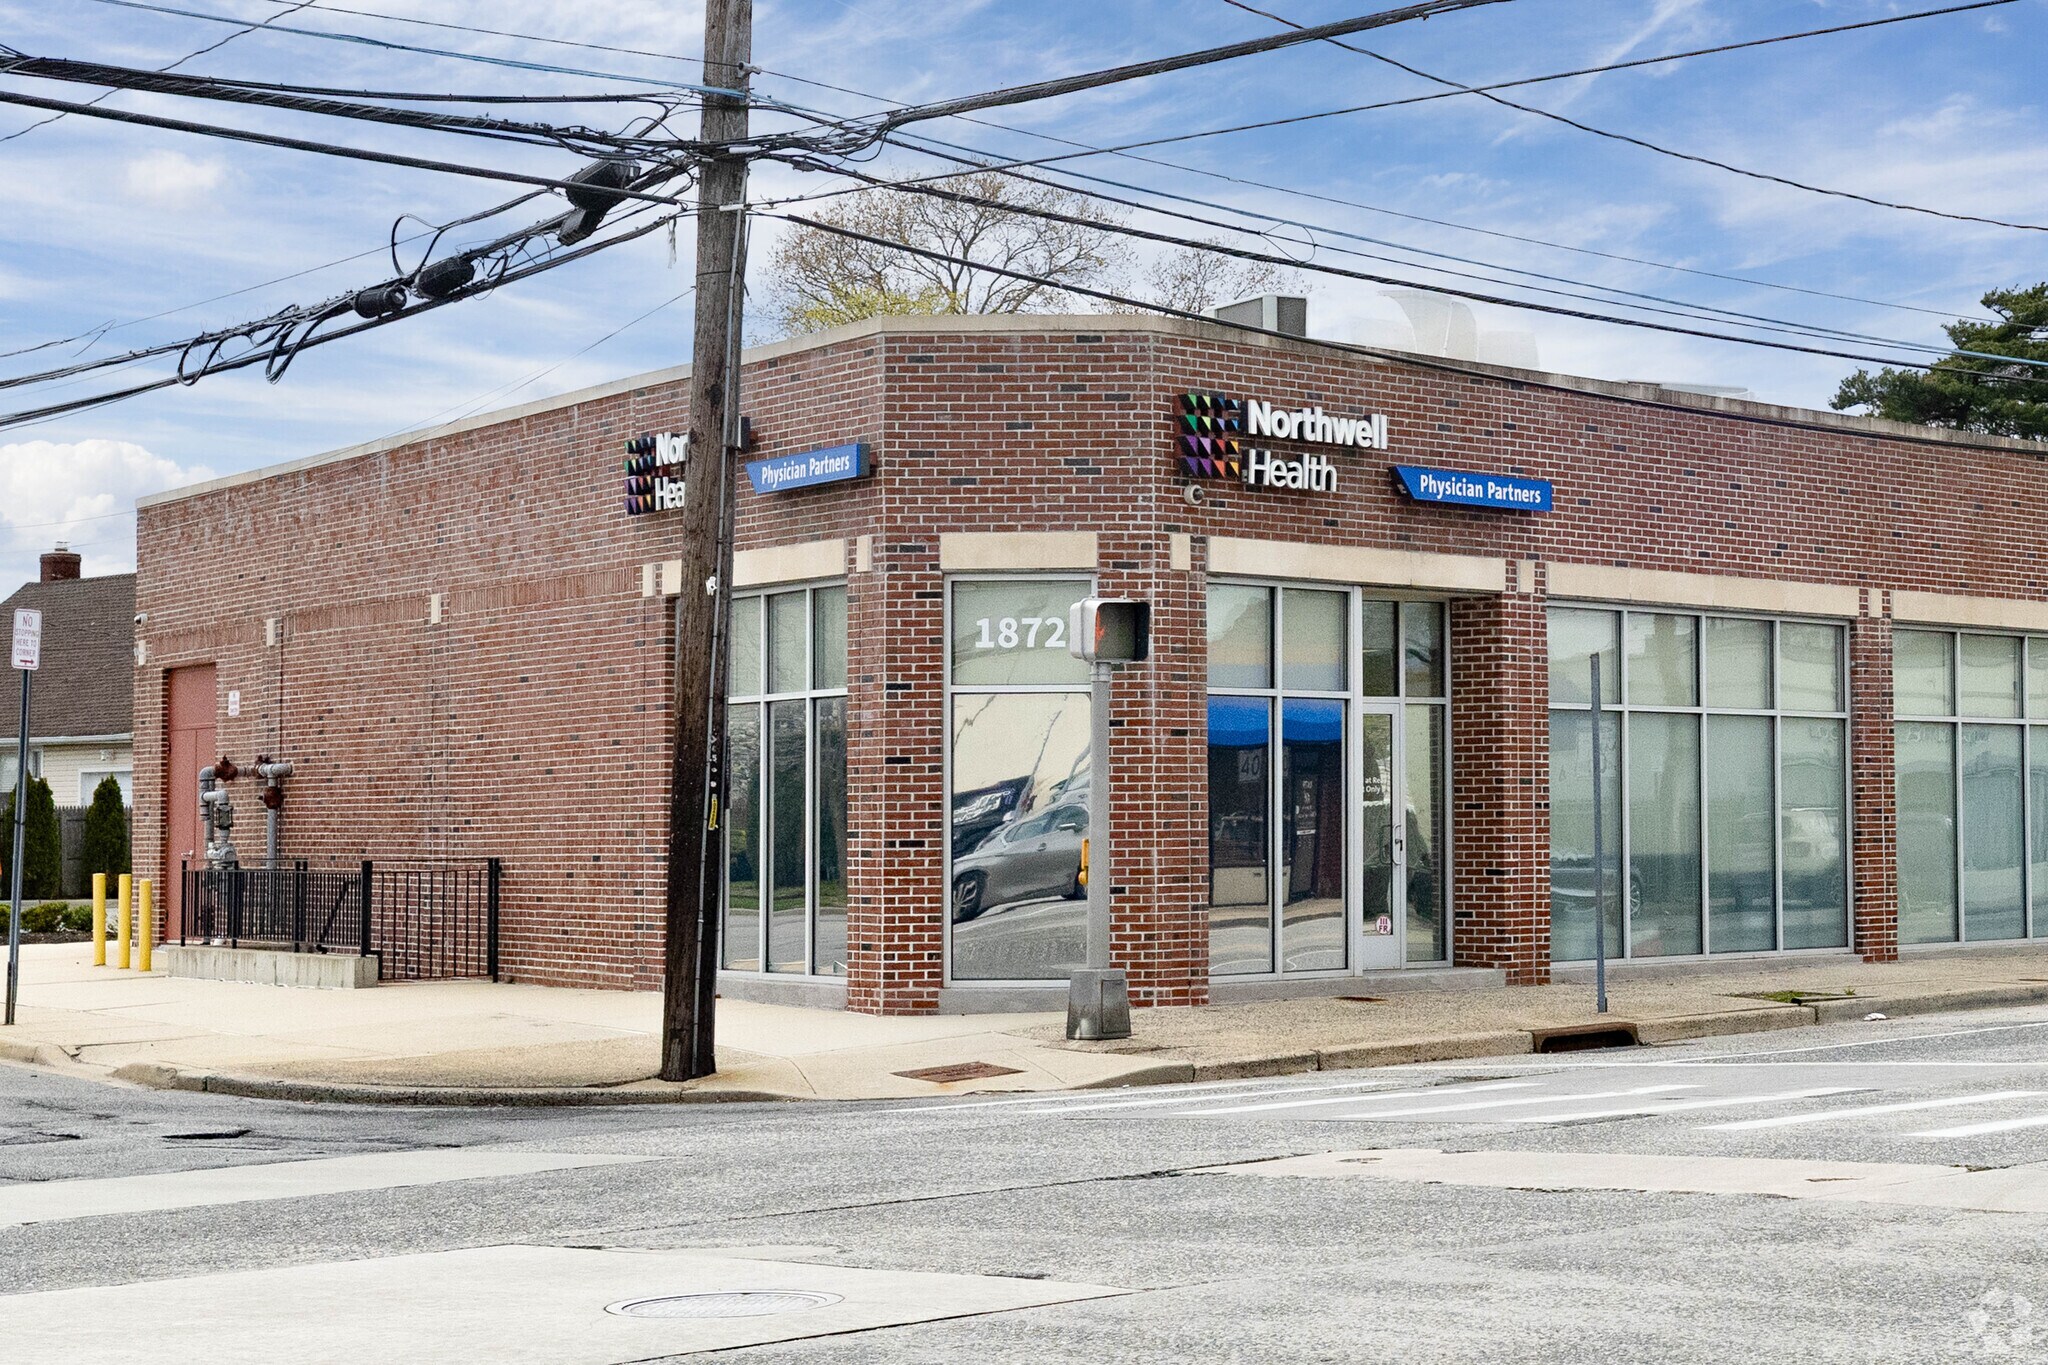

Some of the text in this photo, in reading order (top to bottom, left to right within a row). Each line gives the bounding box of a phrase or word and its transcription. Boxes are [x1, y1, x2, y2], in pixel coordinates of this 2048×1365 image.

[1247, 399, 1388, 450] Northwell
[761, 454, 850, 489] Physician Partners
[1247, 448, 1337, 492] Health
[655, 476, 686, 511] Hea
[1419, 474, 1541, 504] Physician Partners
[15, 628, 39, 637] STOPPING
[22, 616, 33, 627] NO
[975, 616, 1067, 649] 1872
[16, 638, 29, 647] HERE
[16, 648, 36, 657] CORNER
